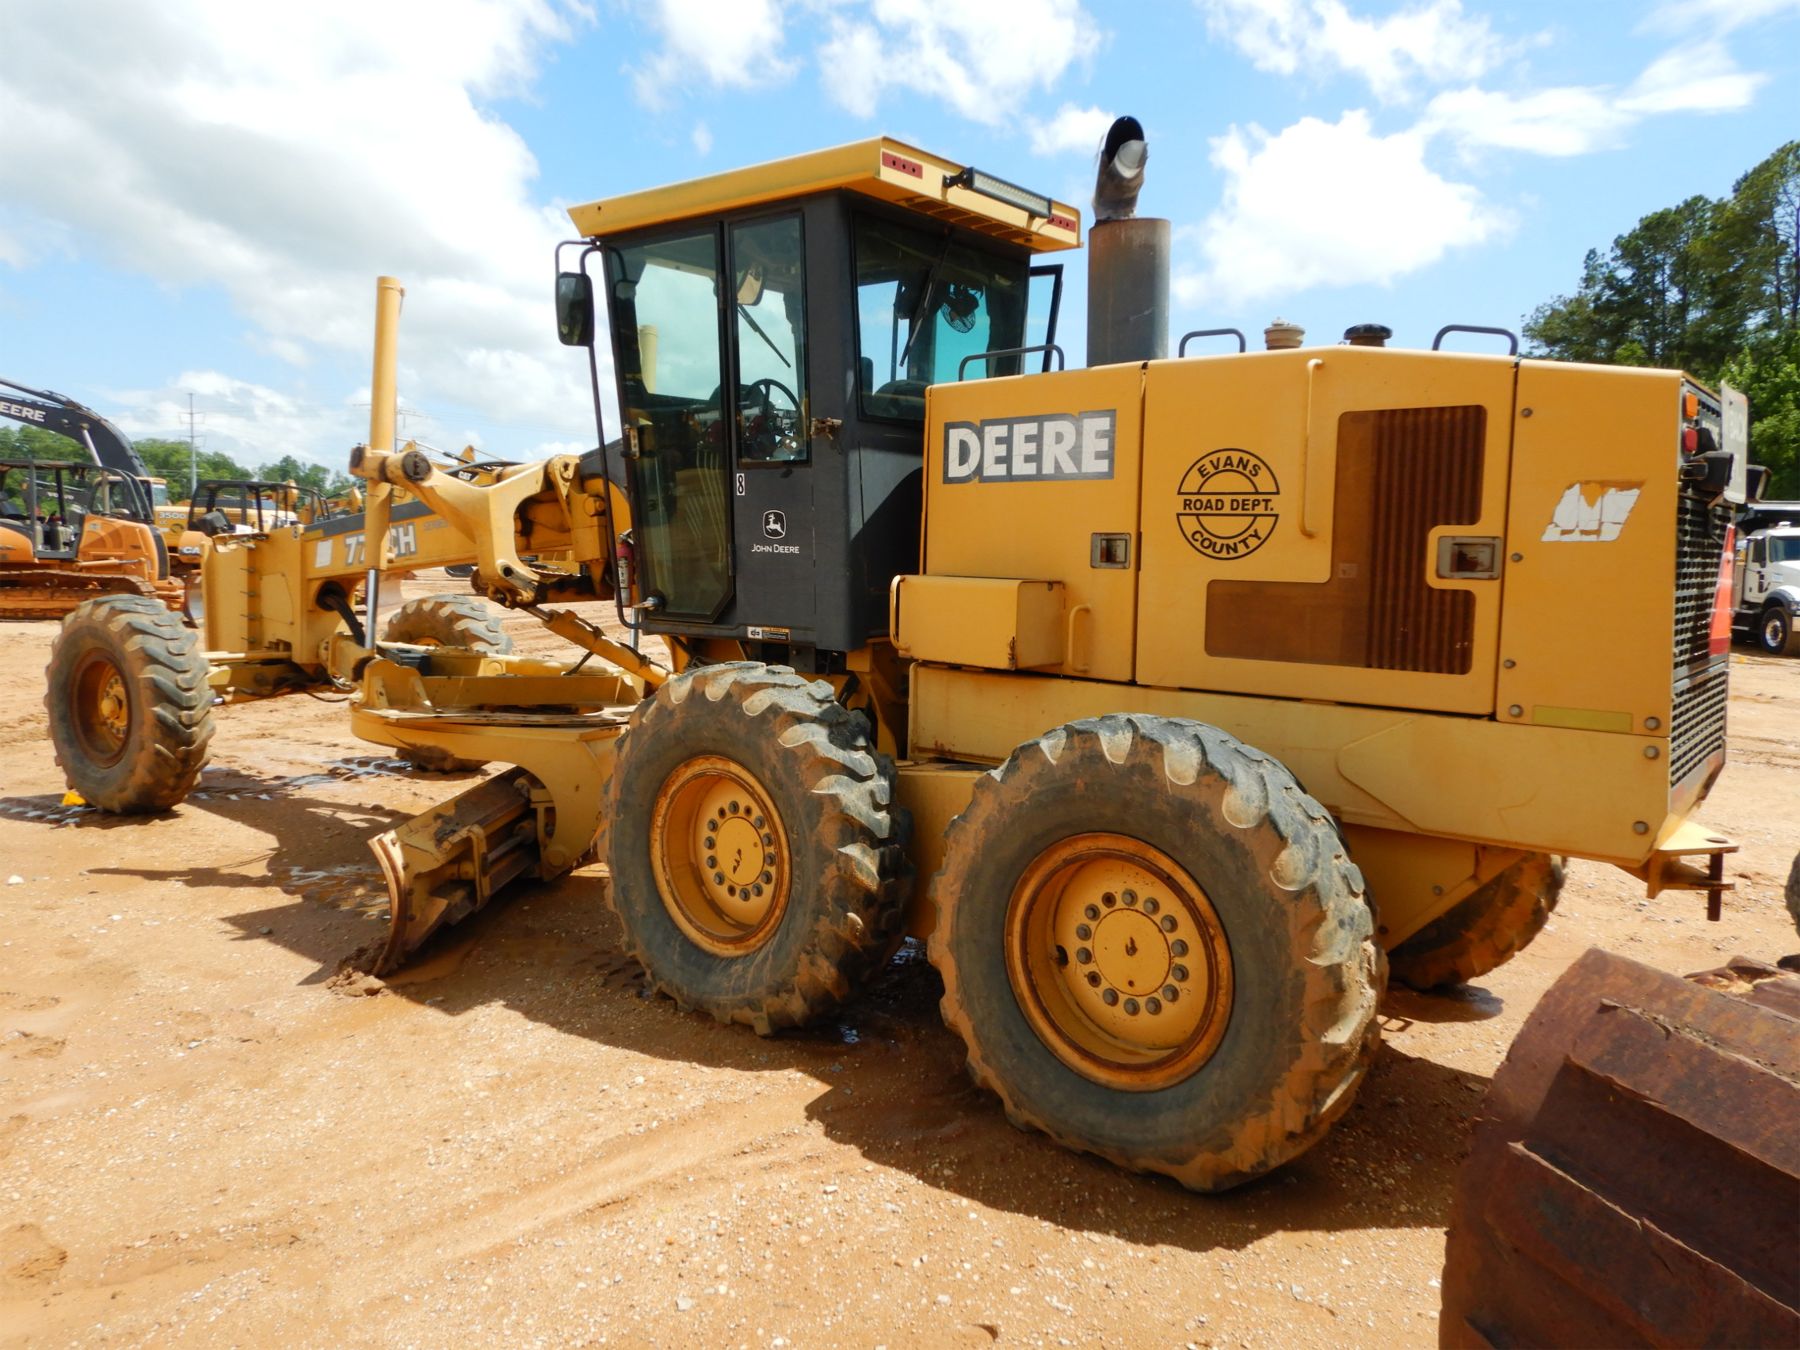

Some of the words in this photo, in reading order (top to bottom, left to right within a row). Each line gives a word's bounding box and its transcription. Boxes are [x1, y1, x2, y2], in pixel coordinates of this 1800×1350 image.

[947, 416, 1112, 479] DEERE
[1197, 455, 1262, 479] EVANS
[737, 474, 744, 494] 8
[47, 491, 75, 500] VOVO
[1183, 498, 1225, 511] ROAD
[1230, 498, 1274, 512] DEPT.
[751, 544, 772, 553] JOHN
[773, 544, 800, 554] DEERE
[1191, 528, 1262, 555] COUNTY
